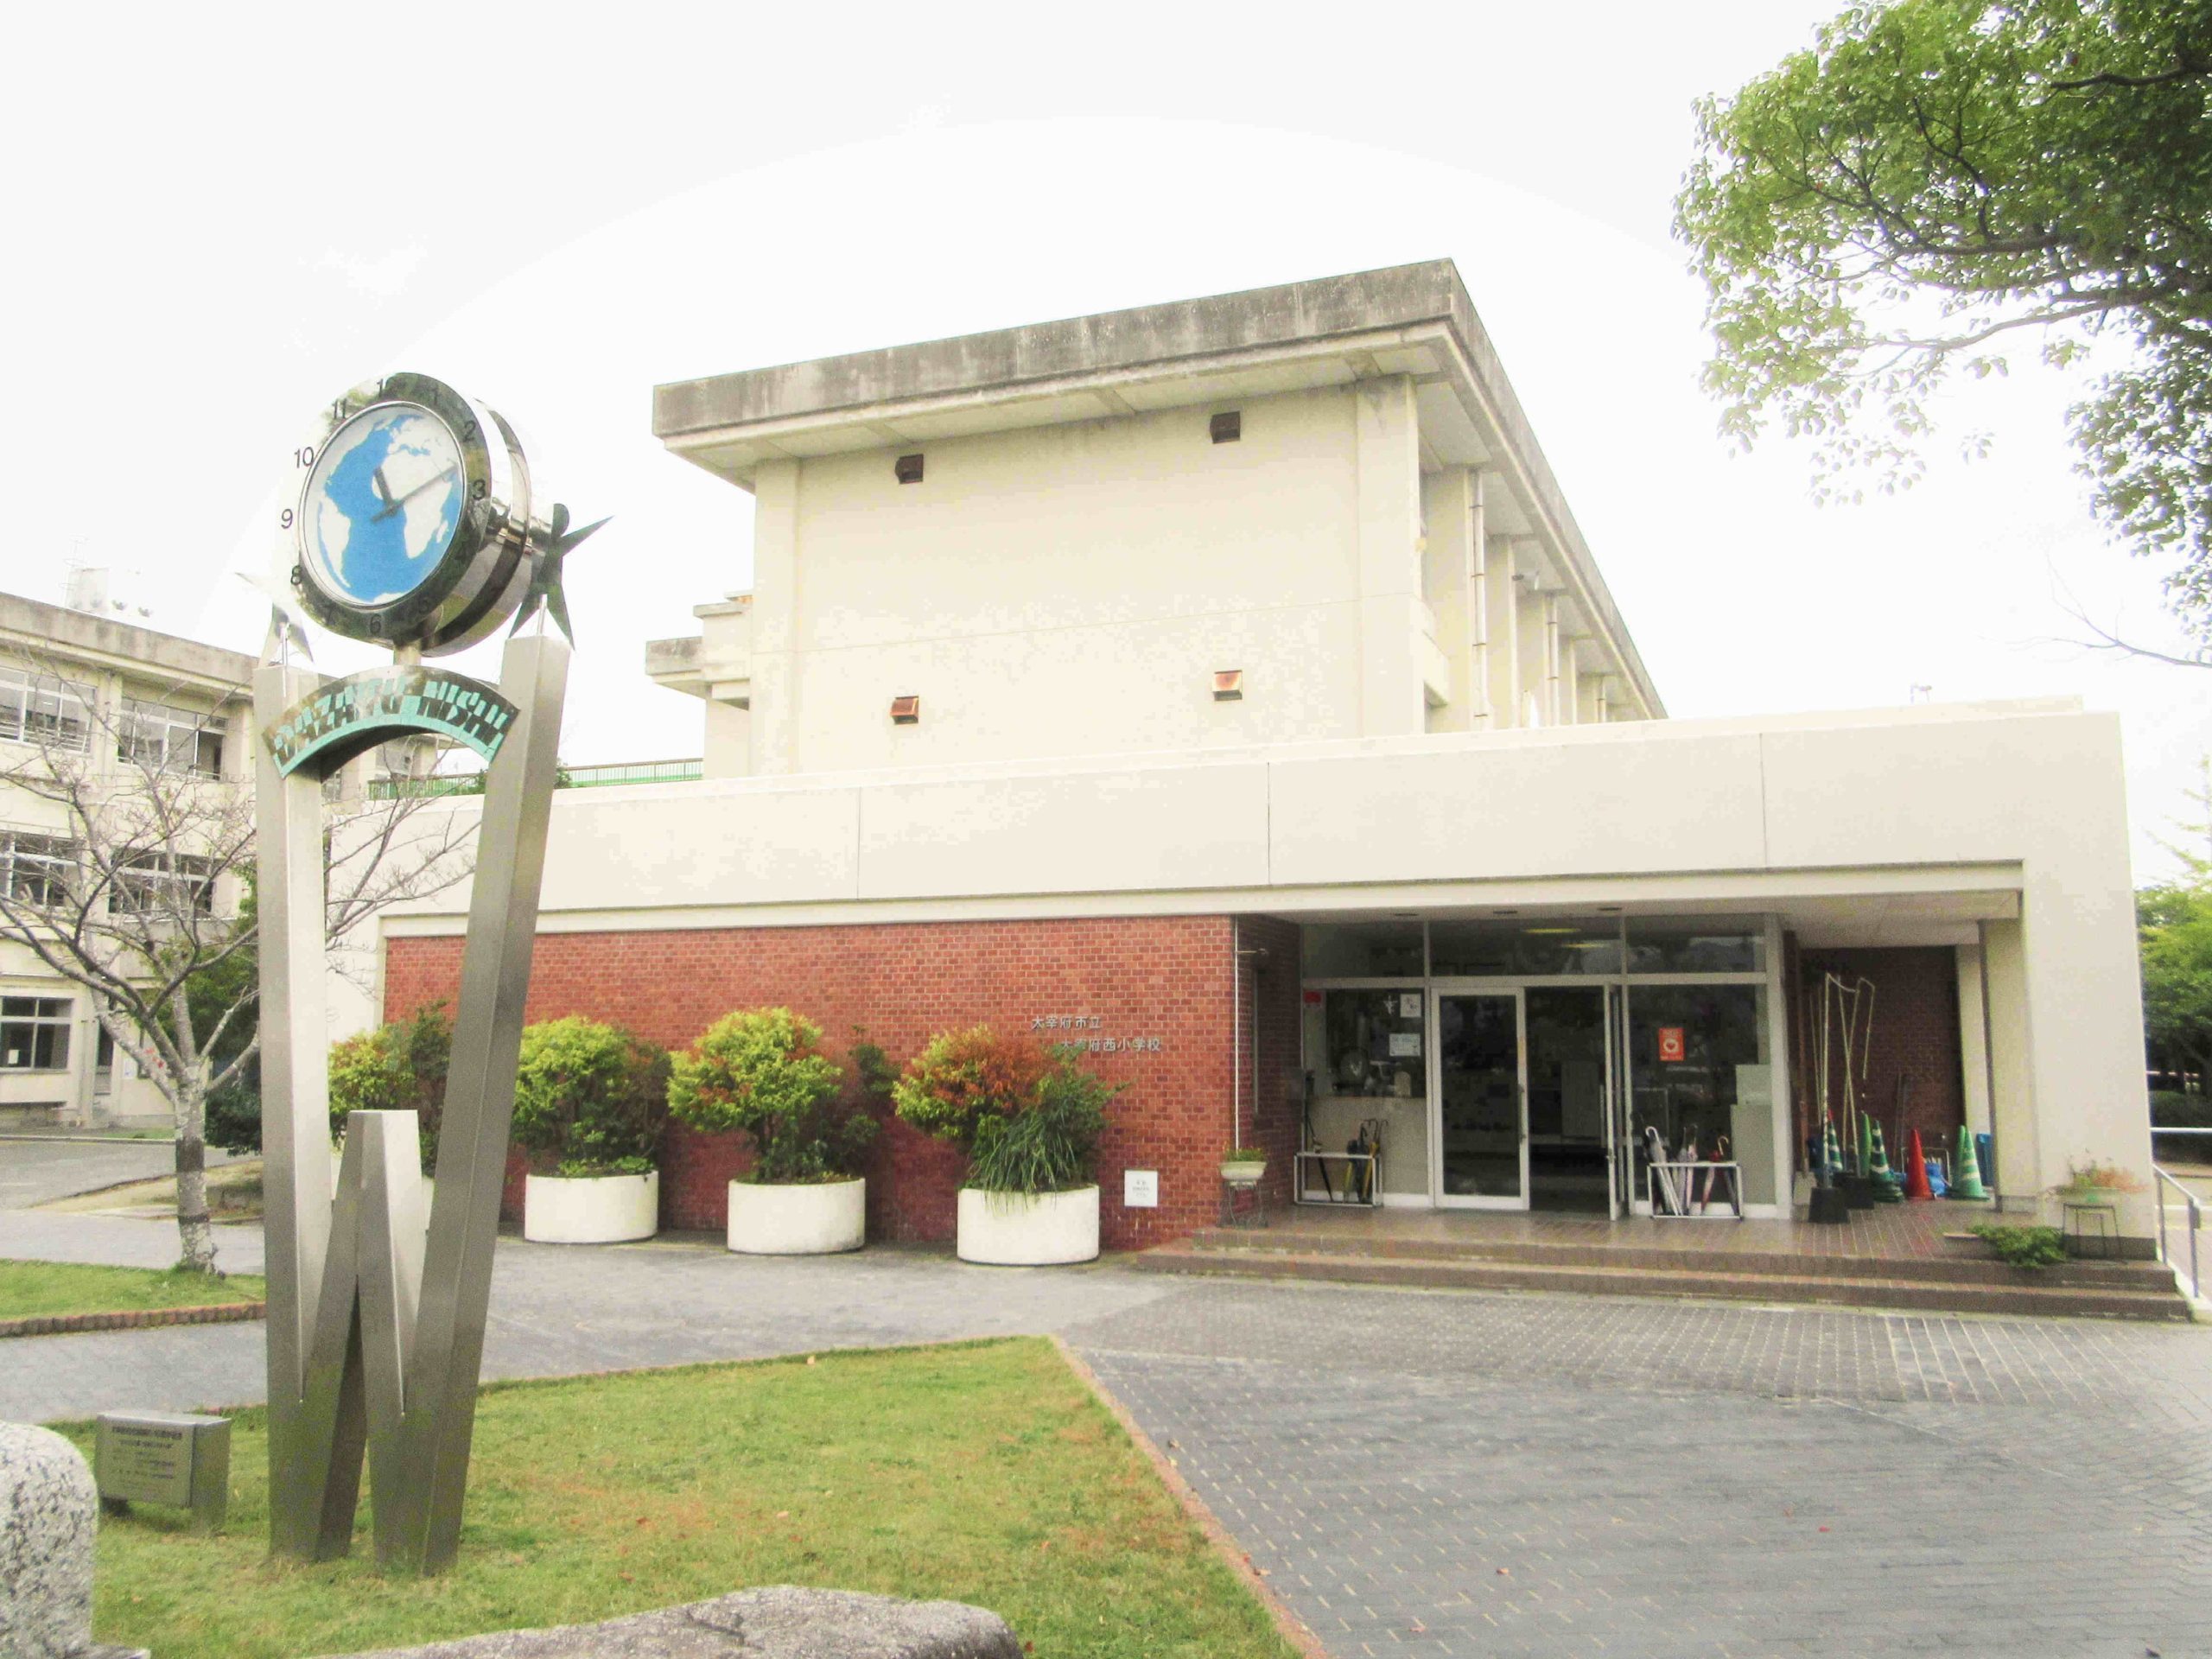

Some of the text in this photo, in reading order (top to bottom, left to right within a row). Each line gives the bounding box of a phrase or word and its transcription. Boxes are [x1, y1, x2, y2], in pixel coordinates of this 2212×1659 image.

[332, 398, 346, 419] 11
[462, 420, 476, 442] 2
[294, 446, 315, 468] 10
[472, 479, 486, 500] 3
[281, 508, 294, 530] 9
[290, 565, 303, 586] 8
[369, 613, 382, 636] 6
[1031, 1015, 1102, 1030] 太宰府市立
